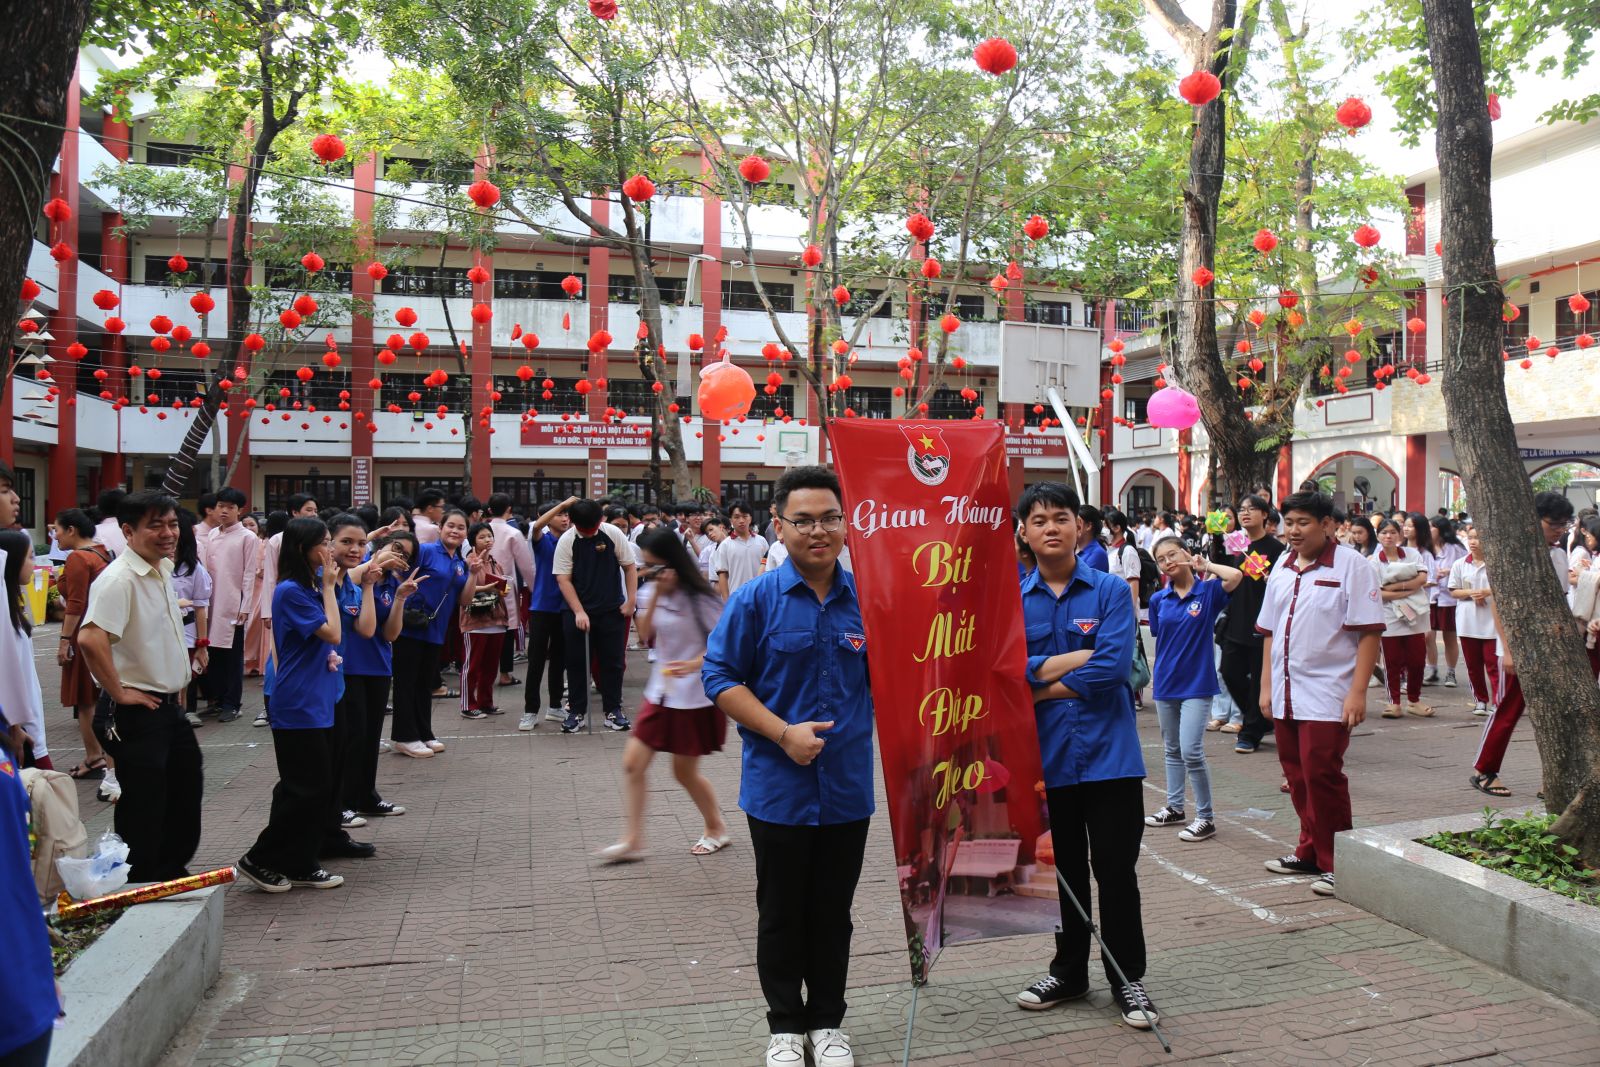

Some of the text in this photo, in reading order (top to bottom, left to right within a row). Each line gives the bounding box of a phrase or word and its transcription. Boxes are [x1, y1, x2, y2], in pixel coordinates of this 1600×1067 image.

[607, 436, 616, 445] VÀ
[616, 436, 634, 445] SÁNG
[635, 437, 647, 447] TẠO
[850, 495, 1007, 539] Gian Hàng
[912, 541, 972, 594] Bịt
[912, 609, 976, 663] Mắt
